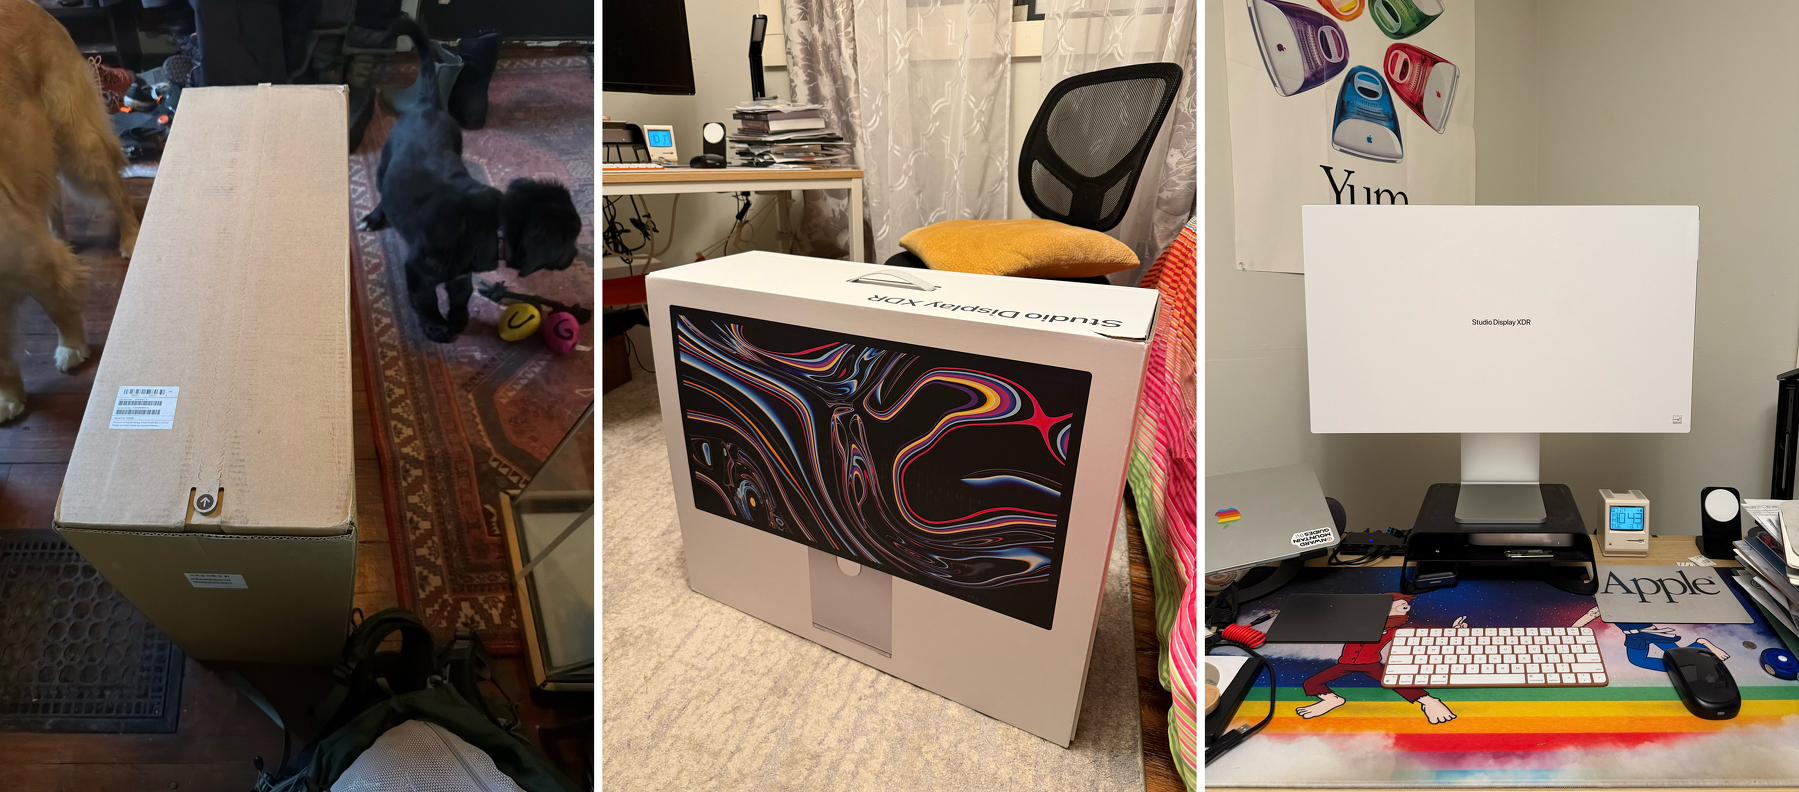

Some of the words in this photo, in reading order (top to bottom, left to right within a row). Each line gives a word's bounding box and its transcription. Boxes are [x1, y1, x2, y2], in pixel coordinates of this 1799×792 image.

[1319, 164, 1408, 205] Yum
[867, 294, 924, 308] XDR
[926, 301, 1021, 319] Display
[1025, 311, 1123, 328] Studio
[1471, 318, 1493, 326] Studio
[1493, 318, 1516, 327] Display
[1516, 318, 1532, 326] XDR
[1293, 533, 1331, 543] MOUNTAIN
[1304, 528, 1329, 536] GUIDES
[1600, 570, 1721, 603] Apple
